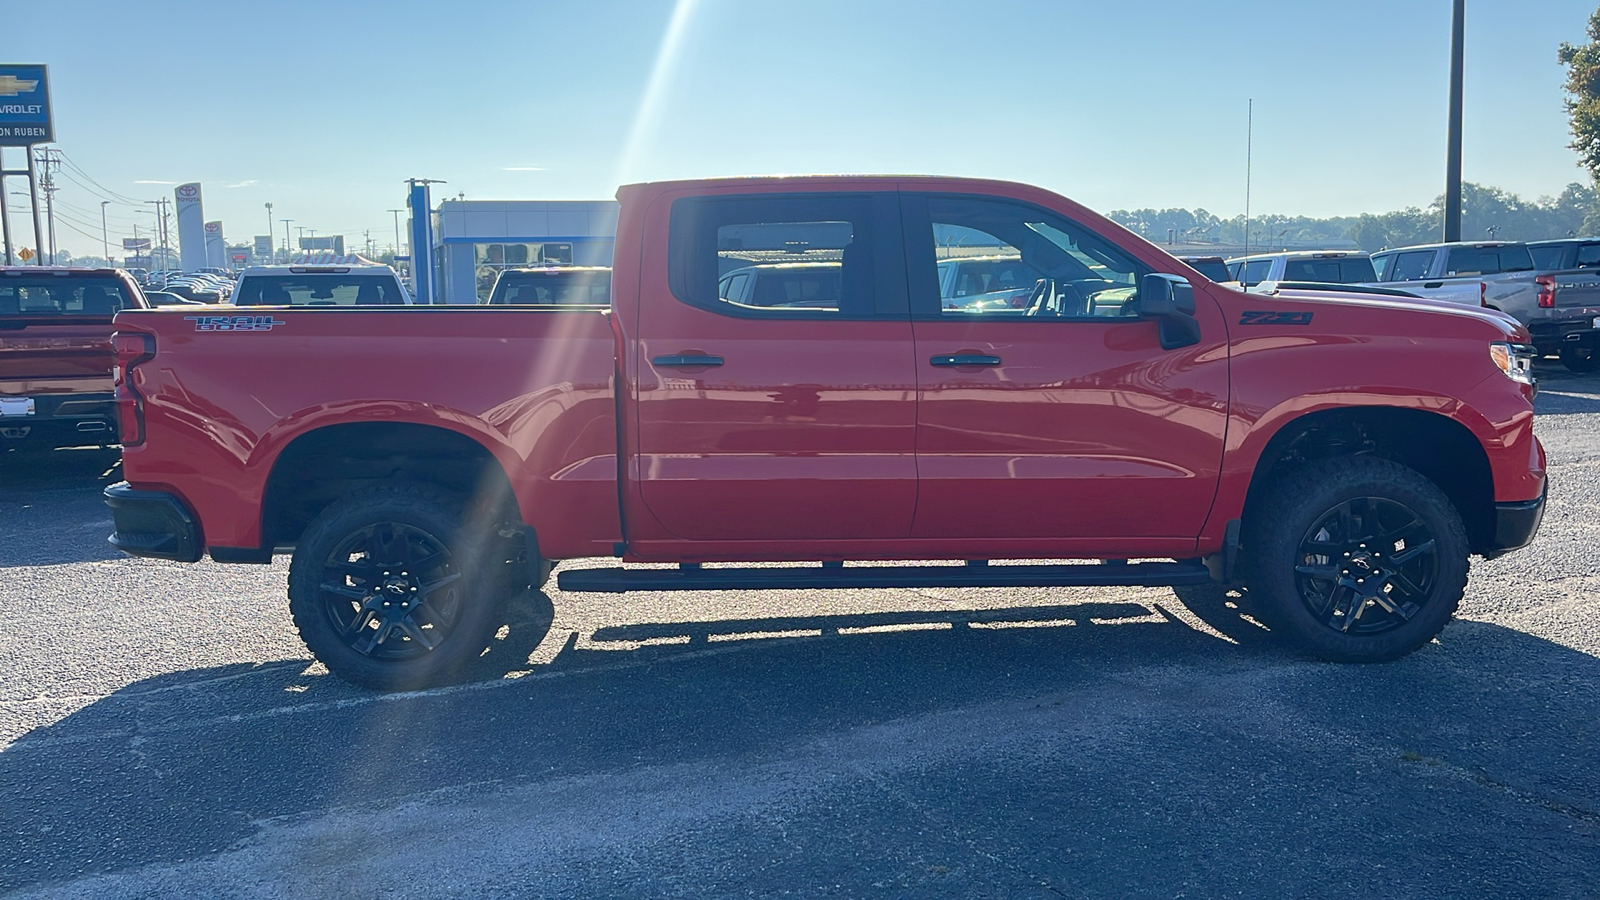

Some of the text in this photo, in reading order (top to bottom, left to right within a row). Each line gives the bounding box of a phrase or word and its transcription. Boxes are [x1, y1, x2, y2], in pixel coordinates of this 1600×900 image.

[14, 127, 46, 136] RUBEN
[184, 316, 285, 325] TRAIL
[1239, 311, 1314, 325] Z71
